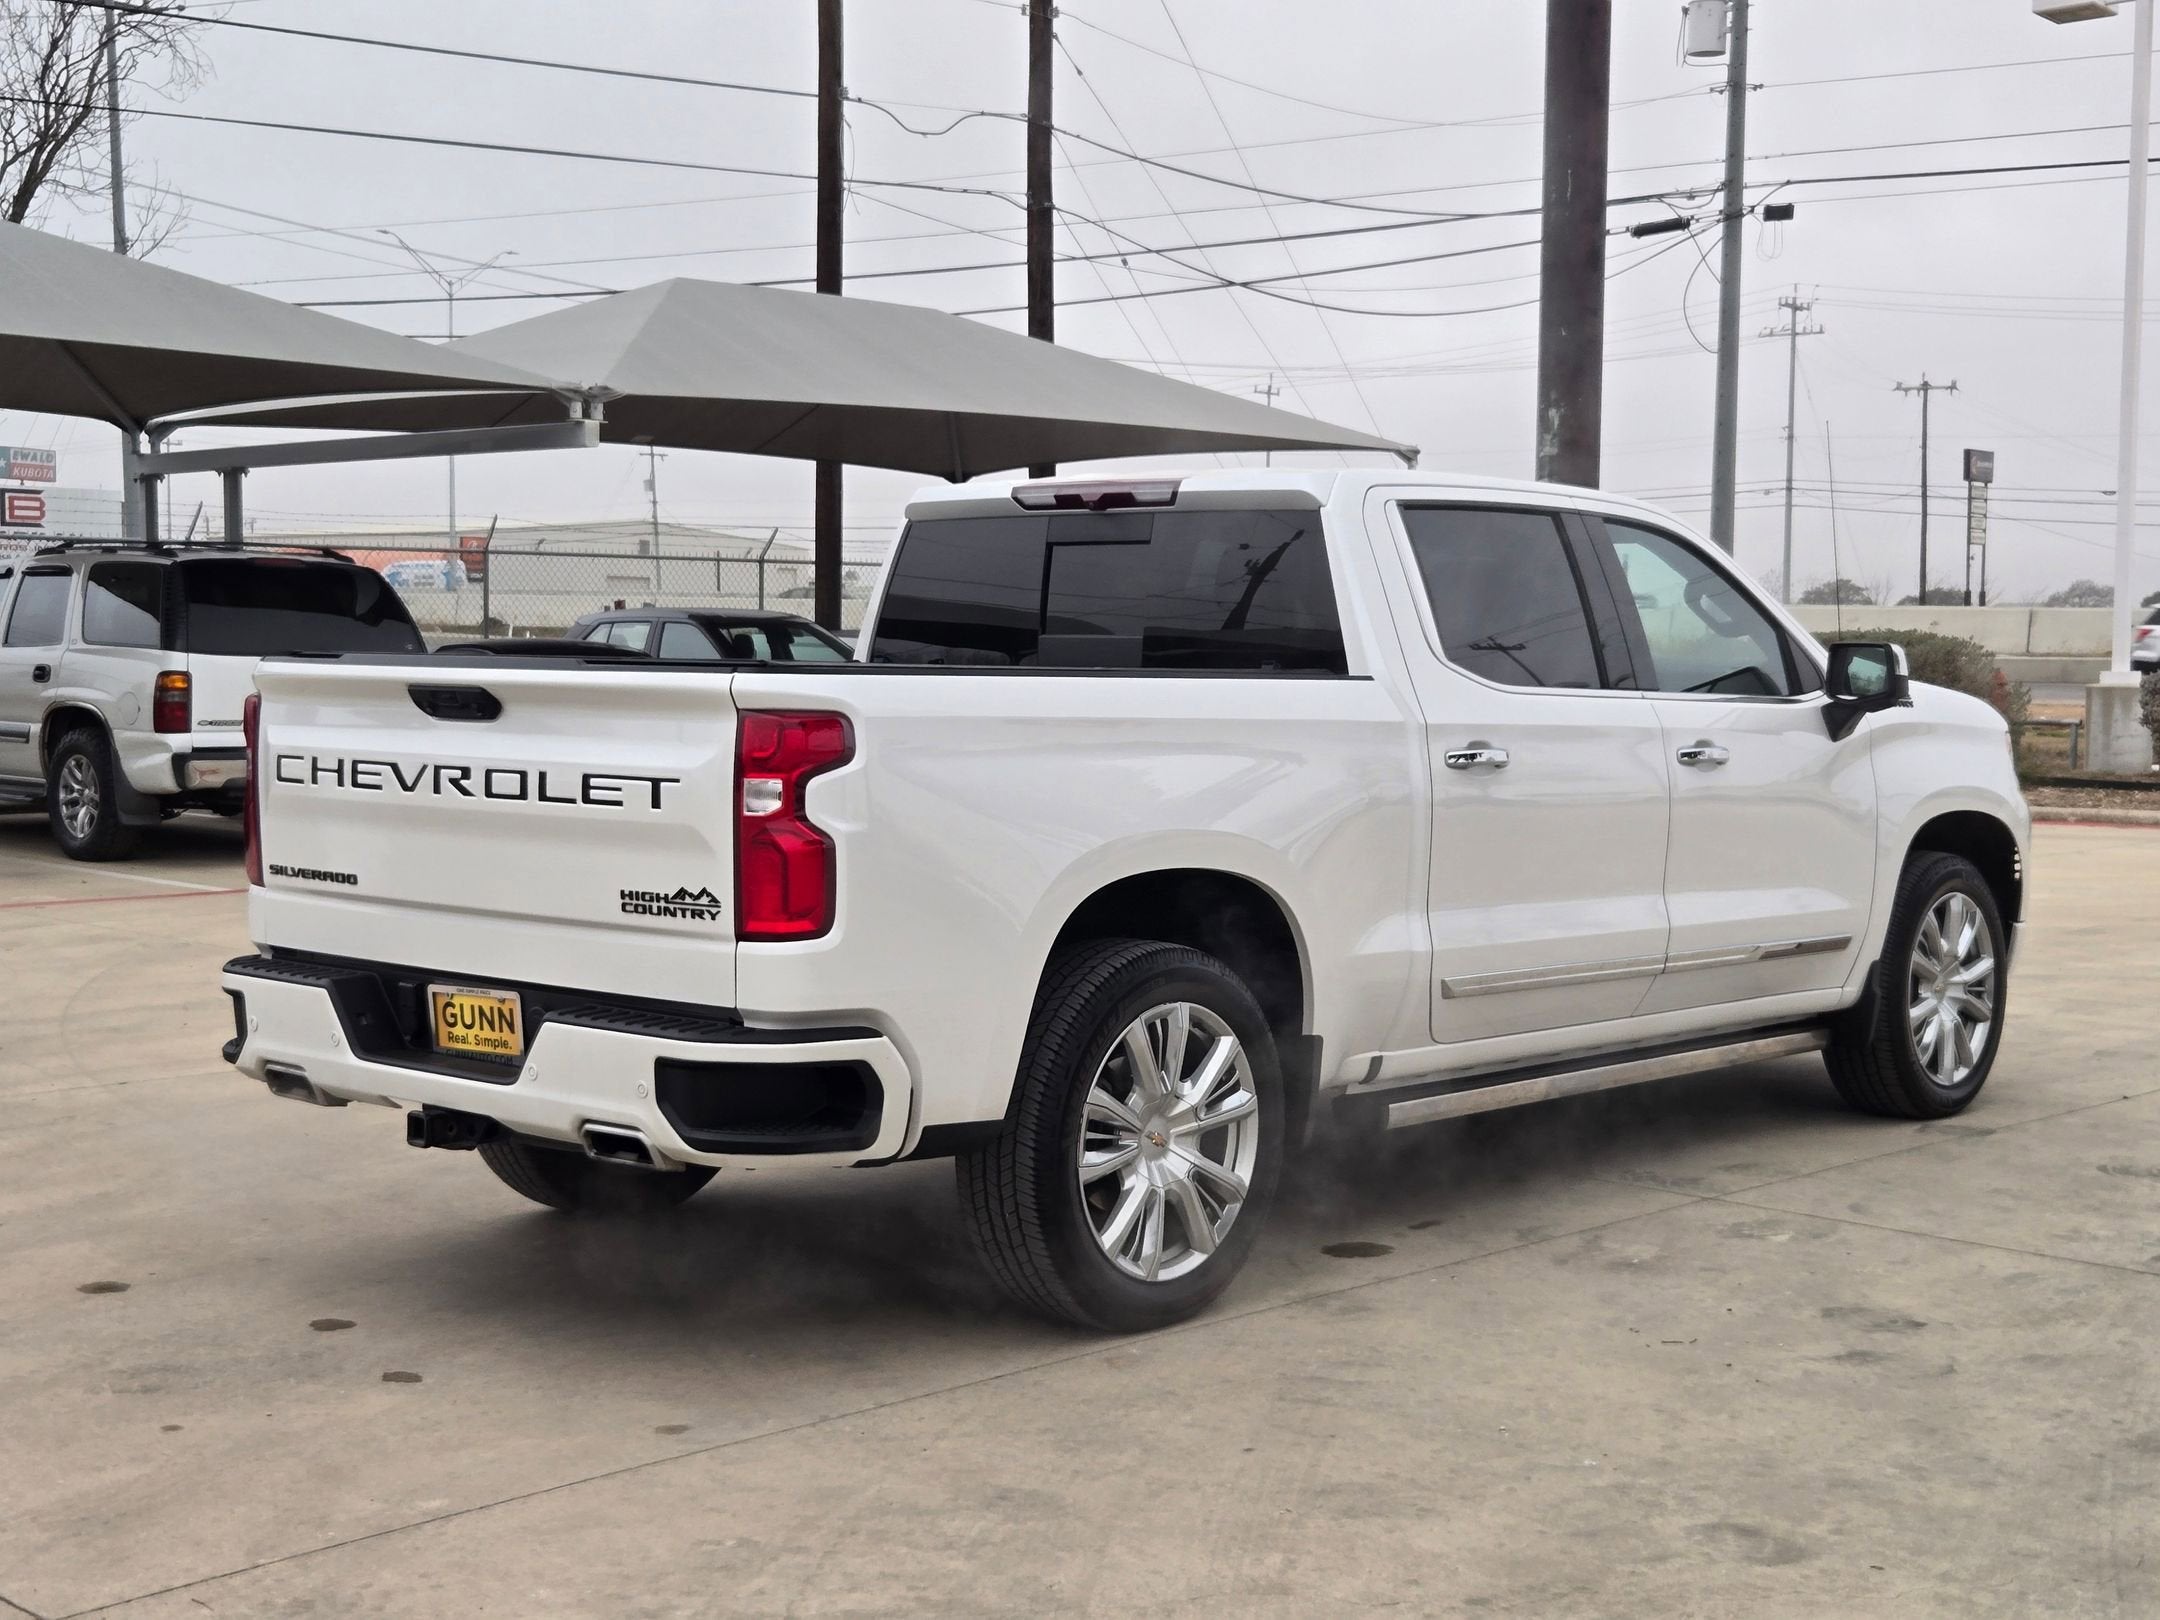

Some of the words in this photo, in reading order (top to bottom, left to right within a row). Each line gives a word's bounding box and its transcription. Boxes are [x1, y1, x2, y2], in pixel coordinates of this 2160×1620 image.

[12, 450, 54, 463] EWALD
[13, 466, 54, 479] KUBOTA
[276, 754, 681, 810] CHEVROLET
[269, 864, 358, 885] SILVERADO
[620, 889, 669, 904] HIGH
[621, 902, 721, 921] COUNTRY
[442, 1001, 516, 1035] GUNN
[447, 1031, 472, 1045] Real.
[474, 1034, 513, 1050] Simple.
